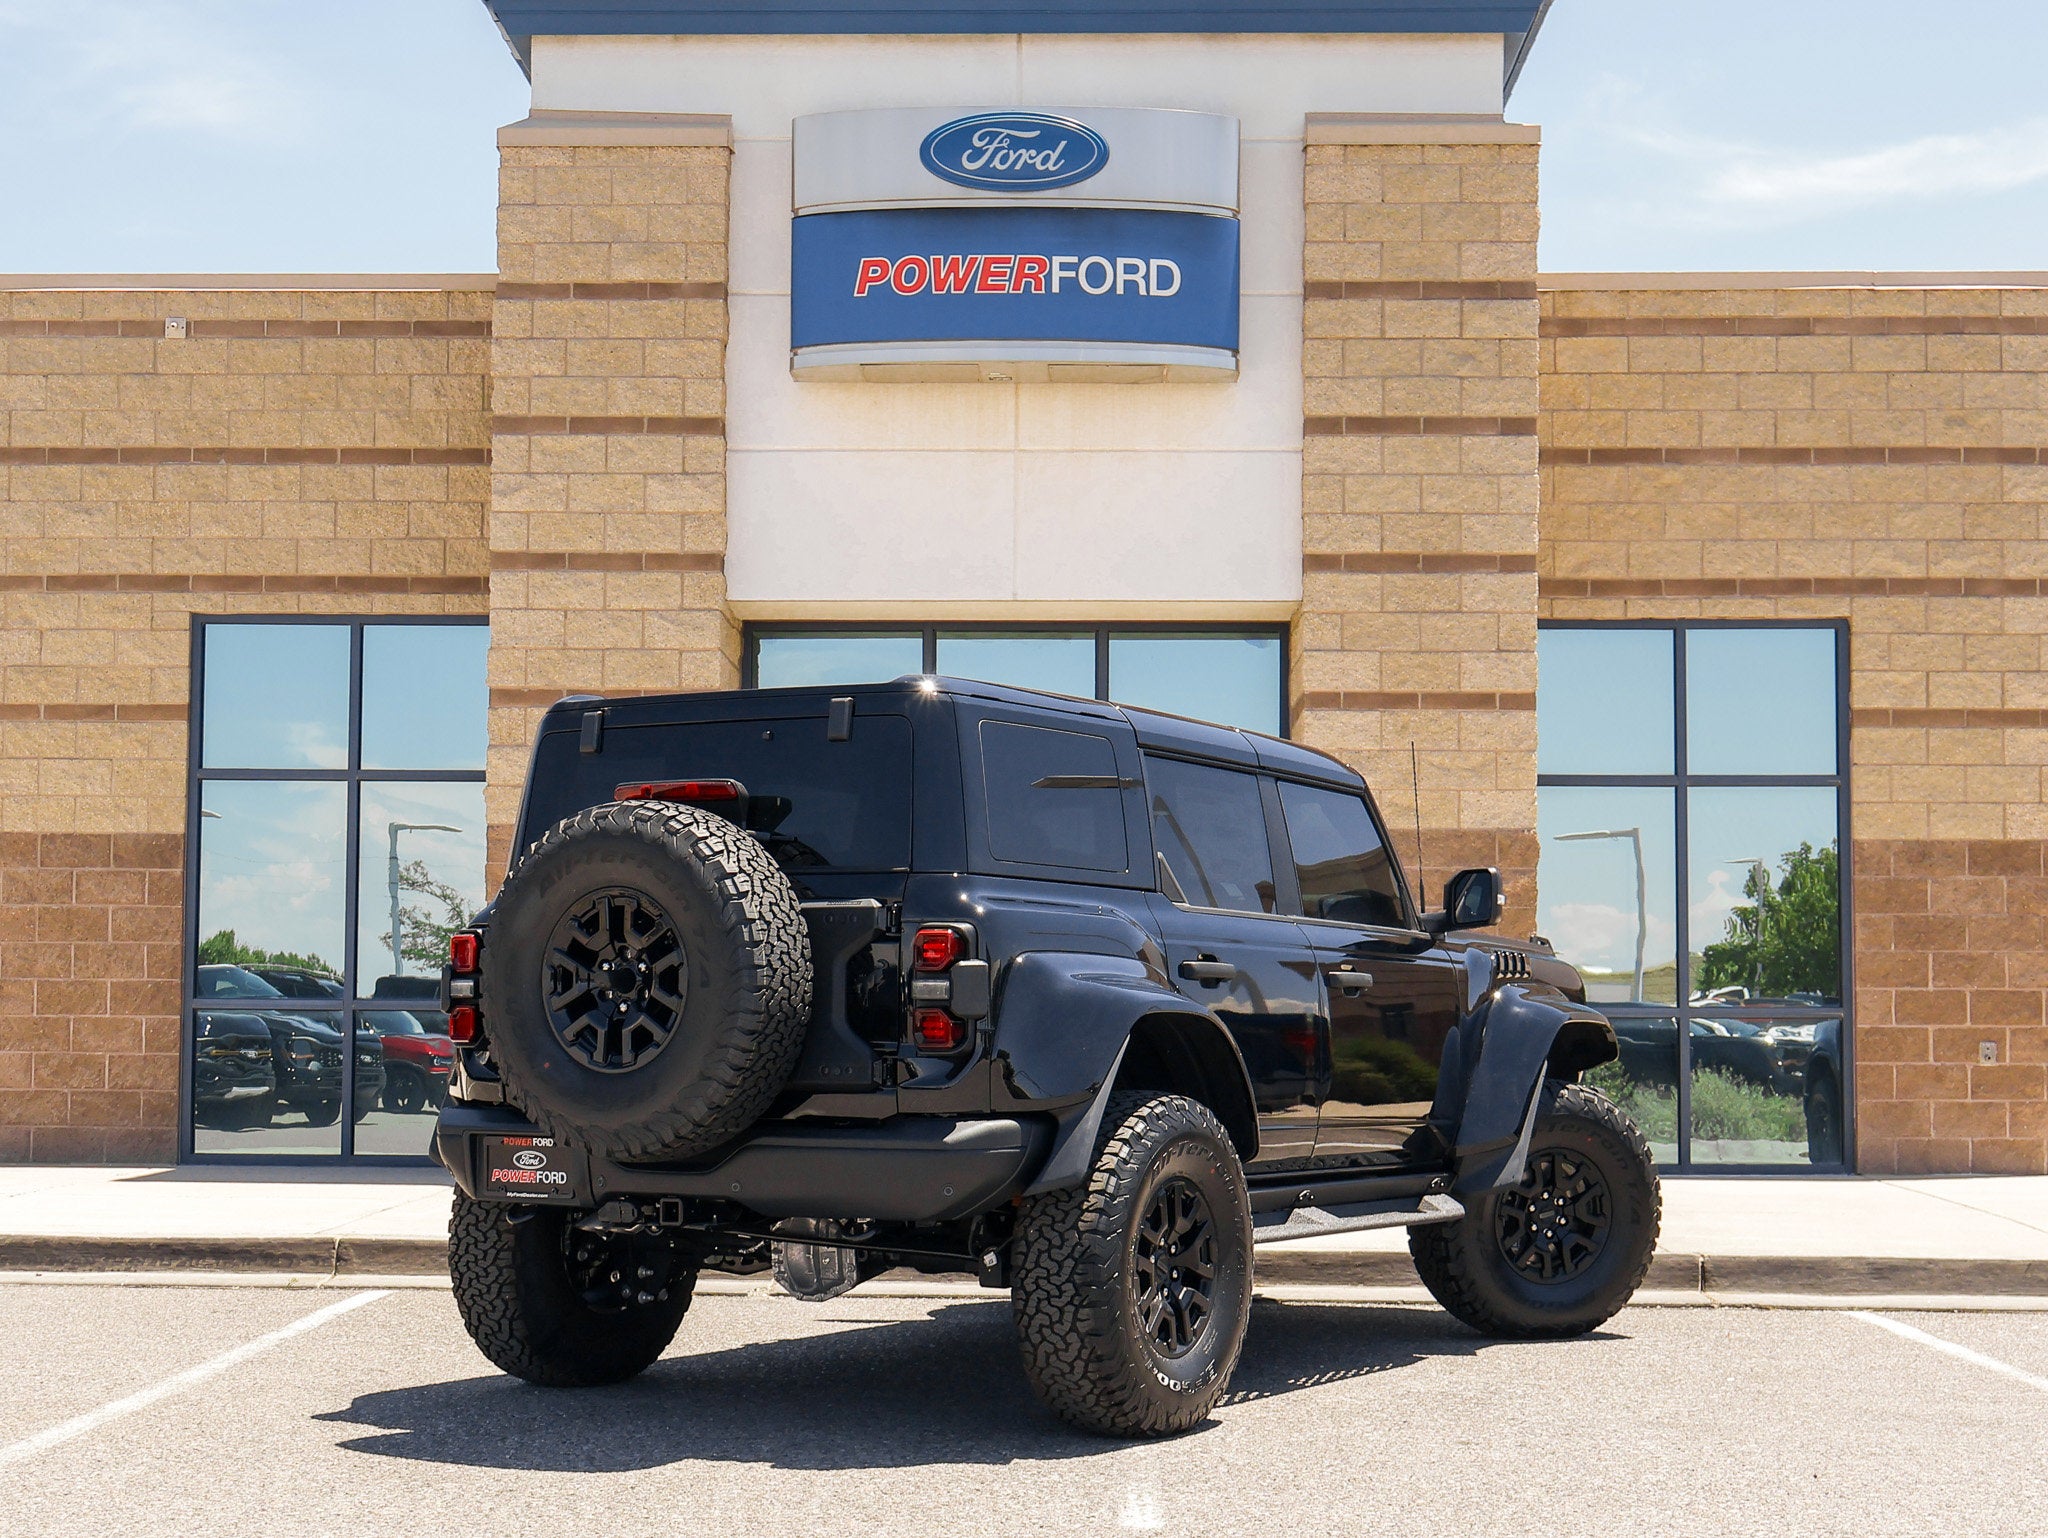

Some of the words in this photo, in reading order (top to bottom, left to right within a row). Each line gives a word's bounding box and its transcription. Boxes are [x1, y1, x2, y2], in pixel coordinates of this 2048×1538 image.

[961, 127, 1067, 172] Ford
[853, 254, 1183, 298] POWERFORD
[502, 1137, 554, 1147] POWERFORD
[519, 1153, 540, 1166] Ford
[491, 1168, 567, 1185] POWERFORD
